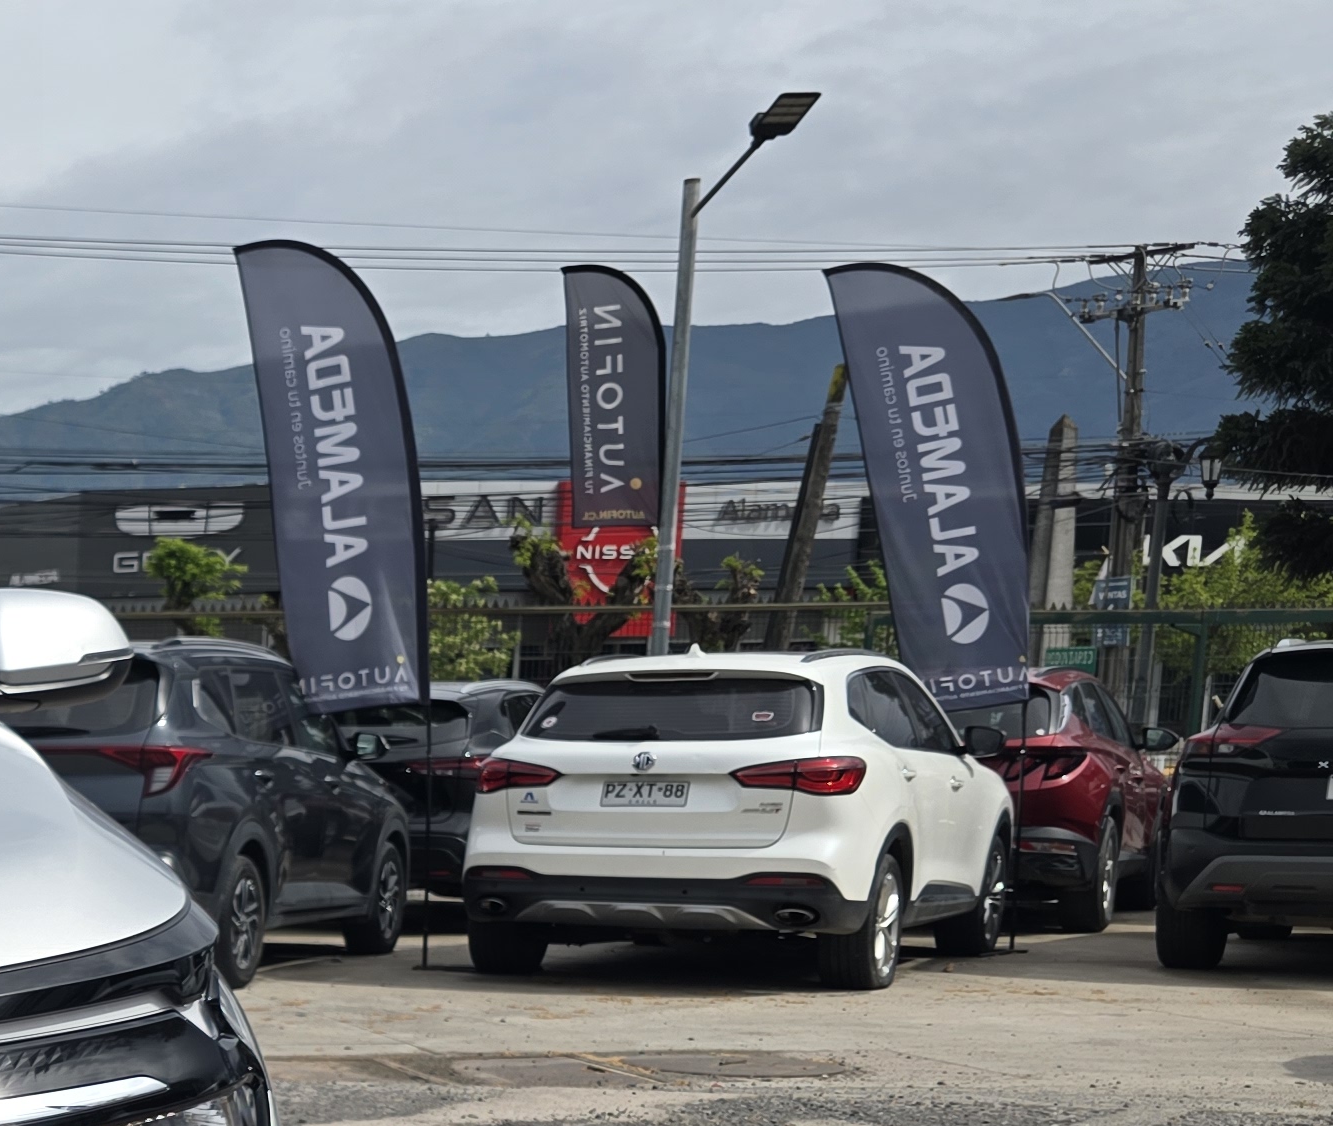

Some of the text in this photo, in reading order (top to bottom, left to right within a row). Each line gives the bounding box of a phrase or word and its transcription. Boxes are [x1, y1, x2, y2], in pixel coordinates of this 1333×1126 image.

[717, 498, 840, 521] Alama
[576, 544, 658, 560] NISS
[1098, 590, 1128, 600] VNTAS
